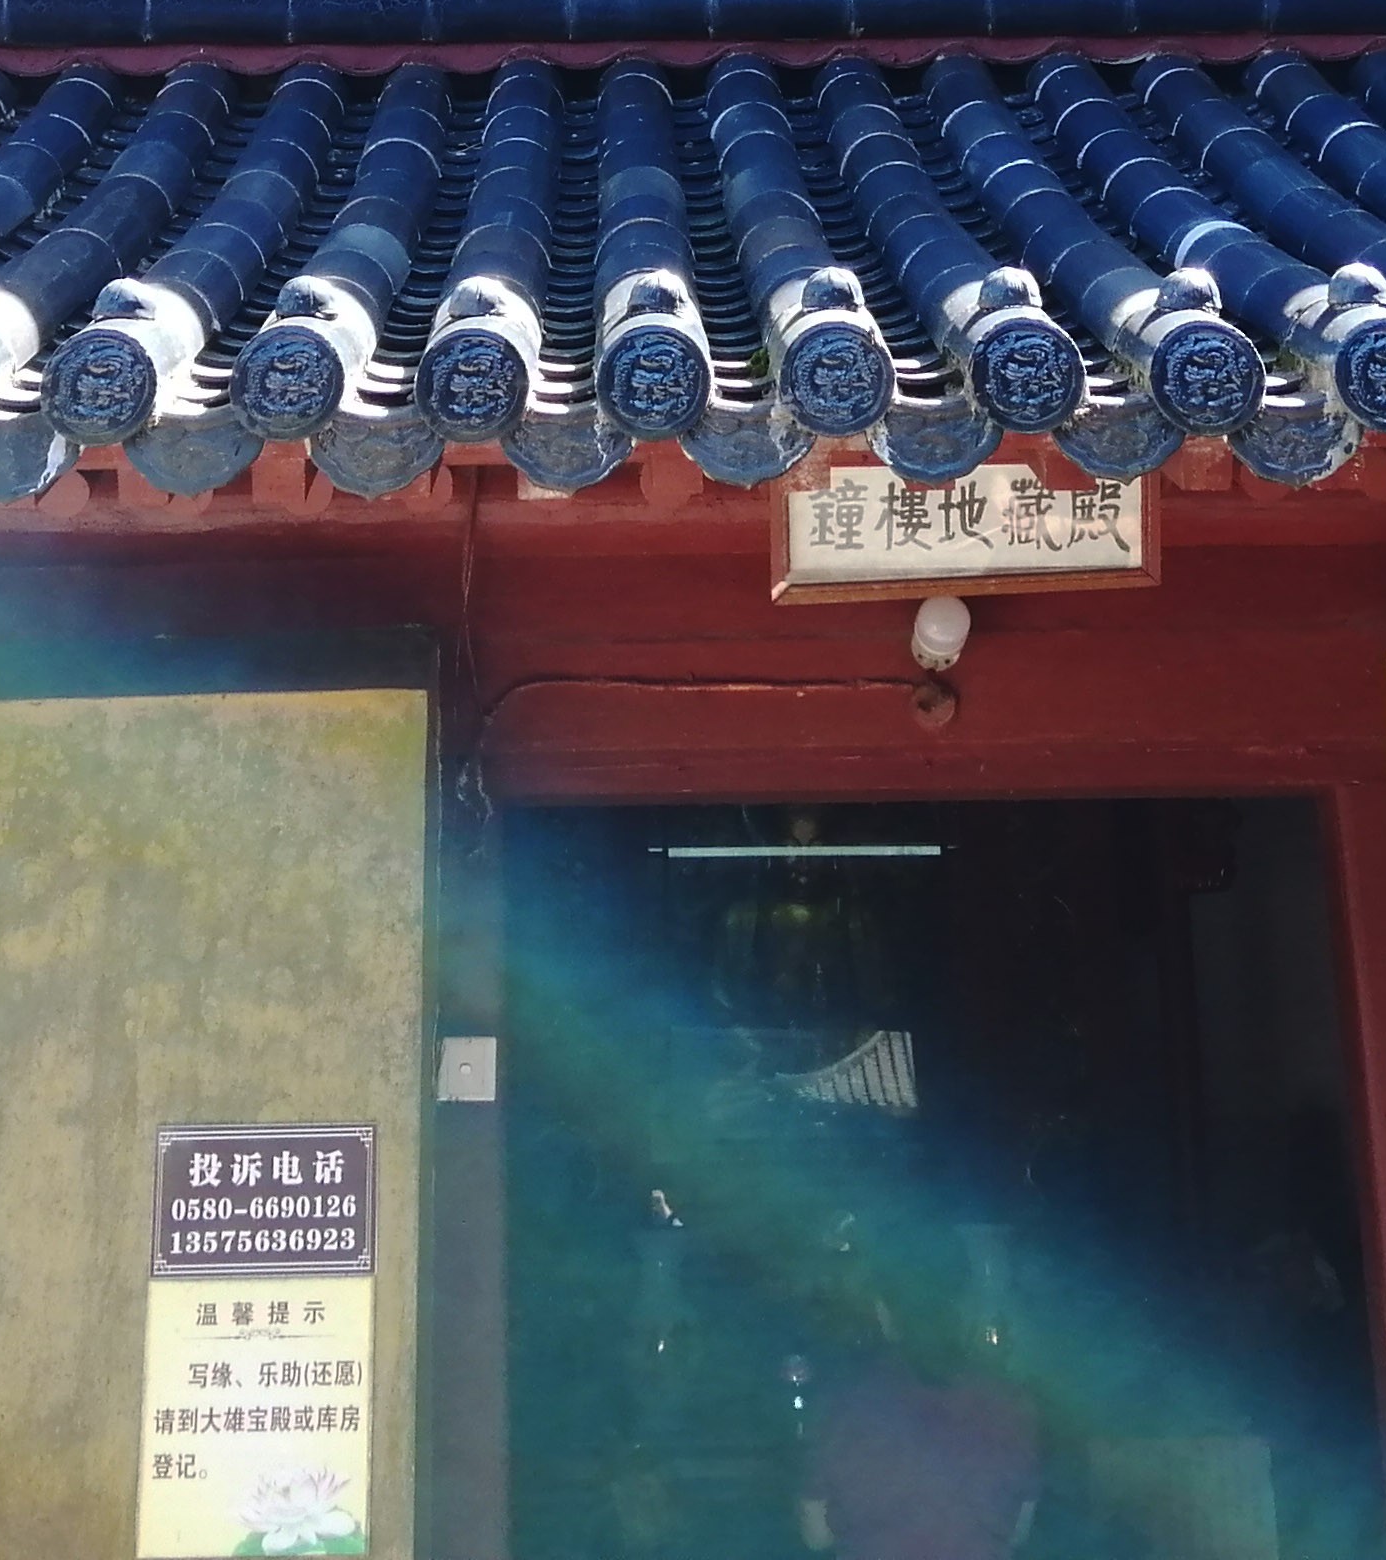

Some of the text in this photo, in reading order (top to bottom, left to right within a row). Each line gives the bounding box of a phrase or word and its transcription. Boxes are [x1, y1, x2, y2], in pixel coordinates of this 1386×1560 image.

[809, 478, 1131, 552] 鐘樓地藏殿
[189, 1149, 345, 1186] 投诉电话
[170, 1195, 357, 1221] 0580-6690126
[169, 1228, 356, 1255] 13575636923
[196, 1301, 326, 1326] 温馨提示
[188, 1360, 362, 1388] 写缘、乐助(还愿)
[153, 1405, 361, 1434] 请到大雄宝殿或库房
[151, 1454, 208, 1480] 登记。
